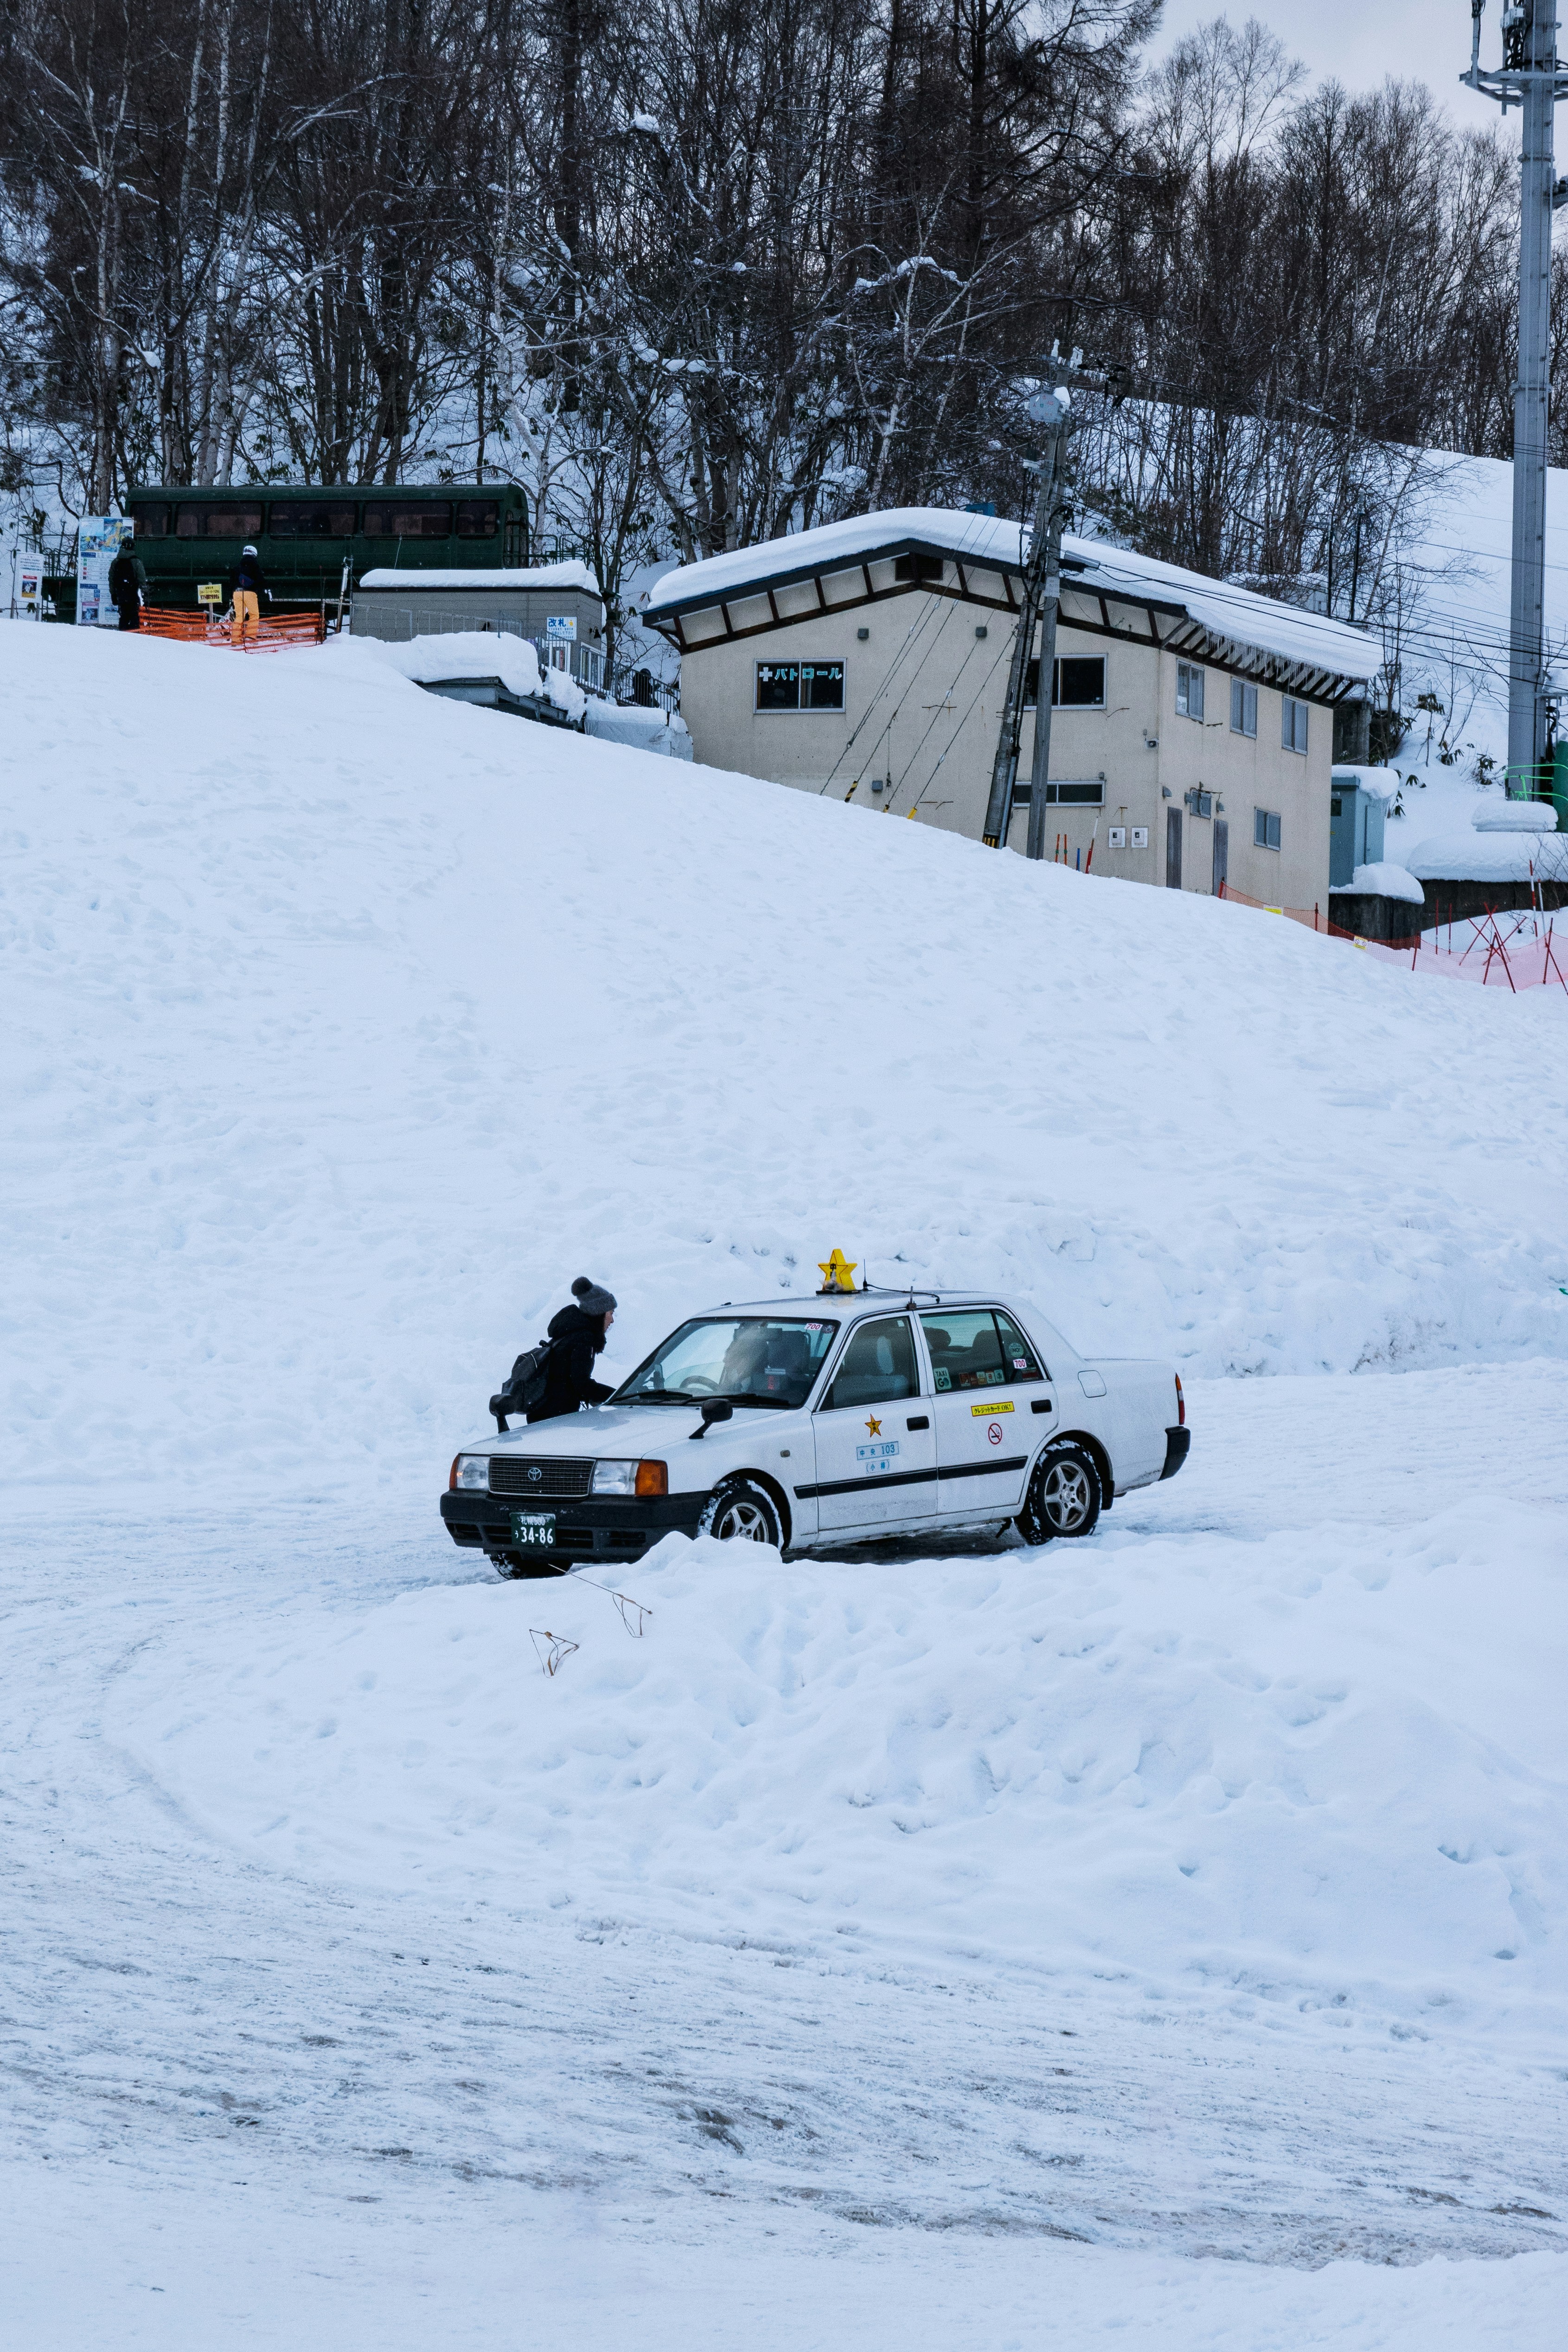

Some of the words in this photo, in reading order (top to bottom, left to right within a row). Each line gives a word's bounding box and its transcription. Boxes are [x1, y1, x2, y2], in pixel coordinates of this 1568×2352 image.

[549, 618, 566, 627] 改札
[774, 668, 842, 680] パトロール
[938, 1378, 949, 1387] GO
[974, 1405, 1000, 1414] クレジットカード
[860, 1448, 875, 1457] 中央
[882, 1444, 895, 1454] 103
[515, 1530, 518, 1538] う
[520, 1526, 553, 1545] 34-86
